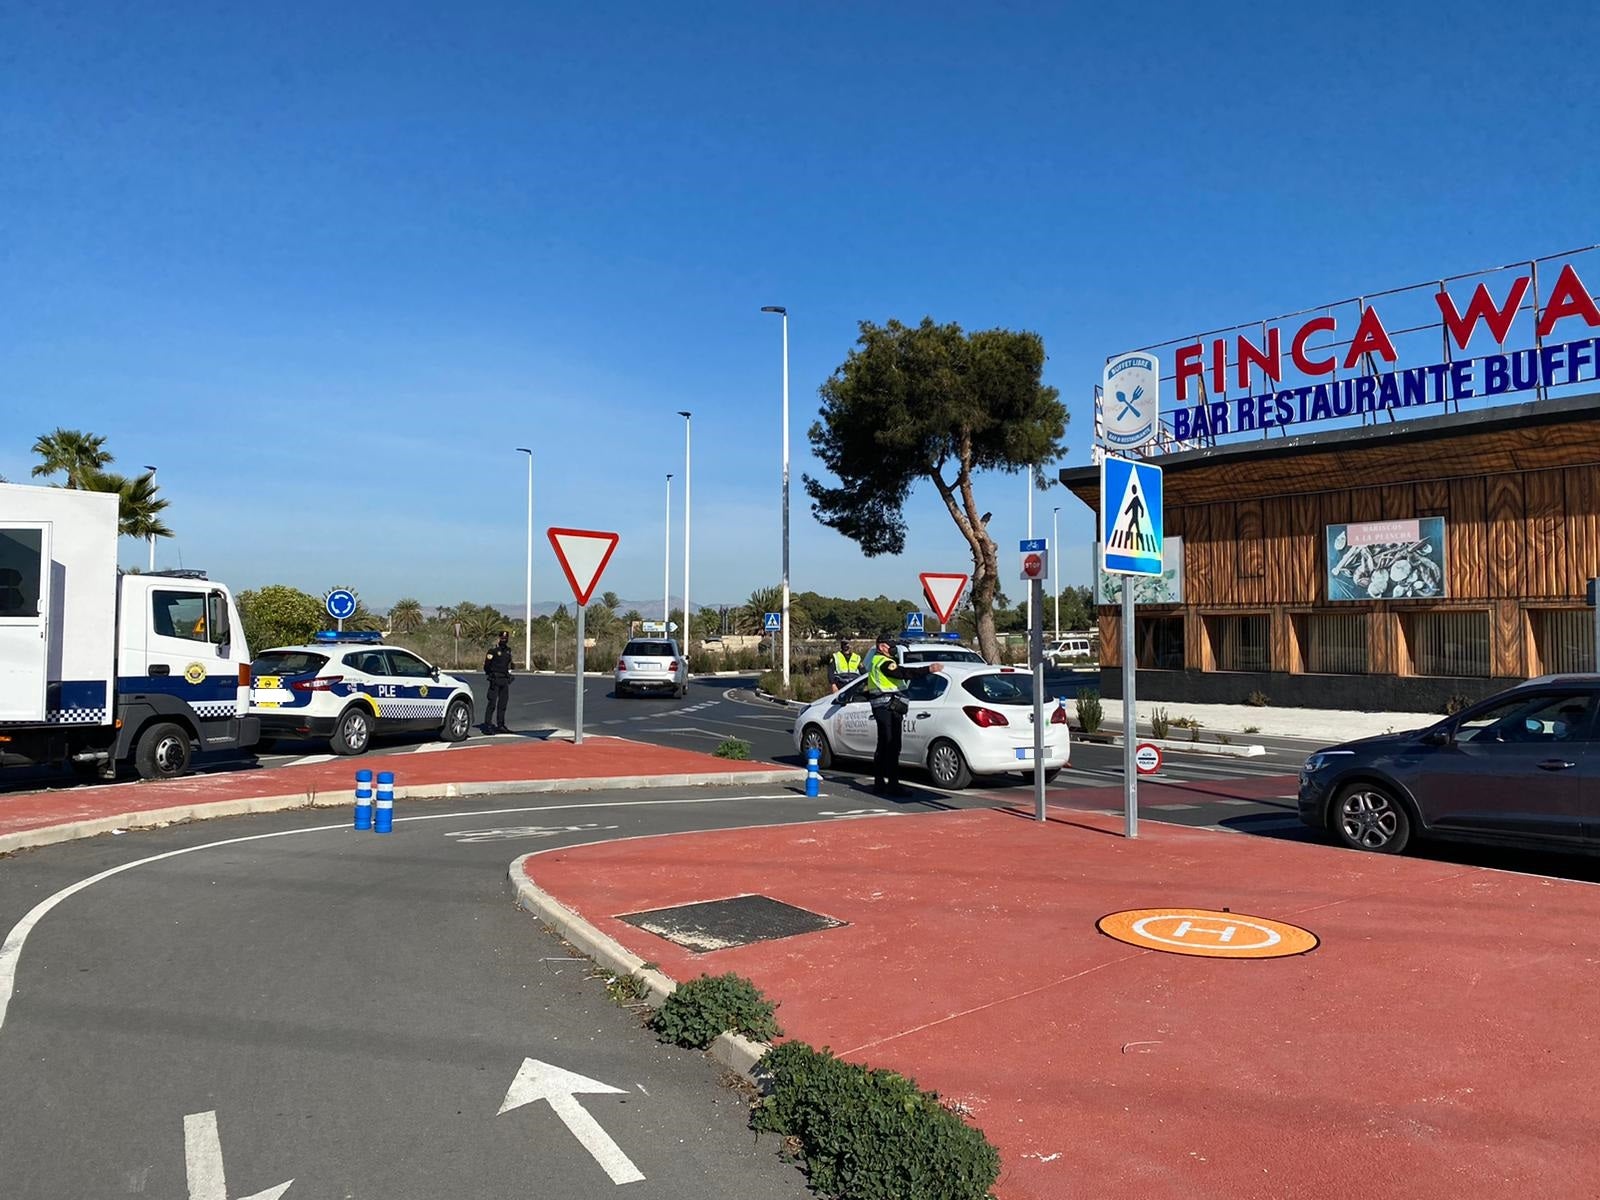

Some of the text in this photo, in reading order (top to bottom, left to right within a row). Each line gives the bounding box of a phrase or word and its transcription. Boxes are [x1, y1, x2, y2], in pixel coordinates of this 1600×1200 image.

[1175, 304, 1398, 401] FINCA
[1111, 359, 1149, 375] BUFFET LIBRE
[1174, 400, 1230, 441] BAR
[1238, 360, 1476, 432] RESTAURANTE
[379, 685, 396, 698] PLE
[903, 720, 917, 733] ELX
[1173, 921, 1237, 942] H
